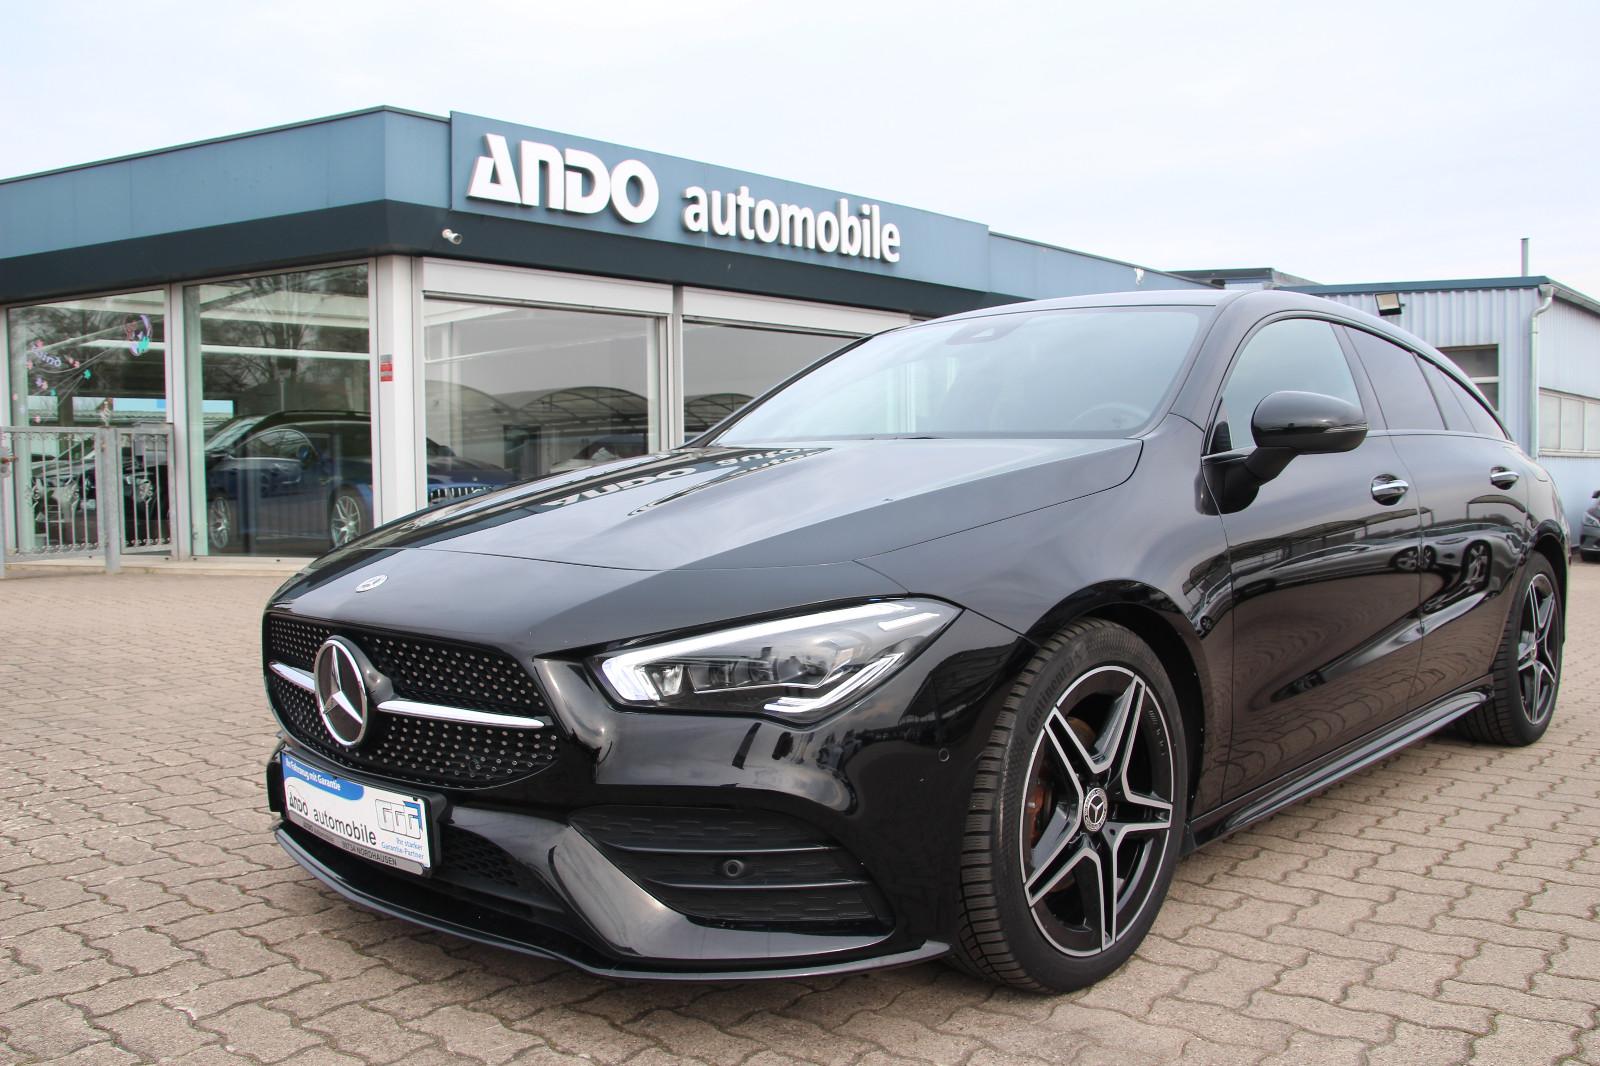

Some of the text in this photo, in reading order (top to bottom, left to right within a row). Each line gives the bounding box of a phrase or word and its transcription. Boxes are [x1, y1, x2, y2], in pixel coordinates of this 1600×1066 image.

[466, 132, 901, 263] ANDO automobile
[317, 774, 341, 791] Garantie
[313, 808, 377, 845] automobile
[355, 846, 397, 866] NORDHAUSEN
